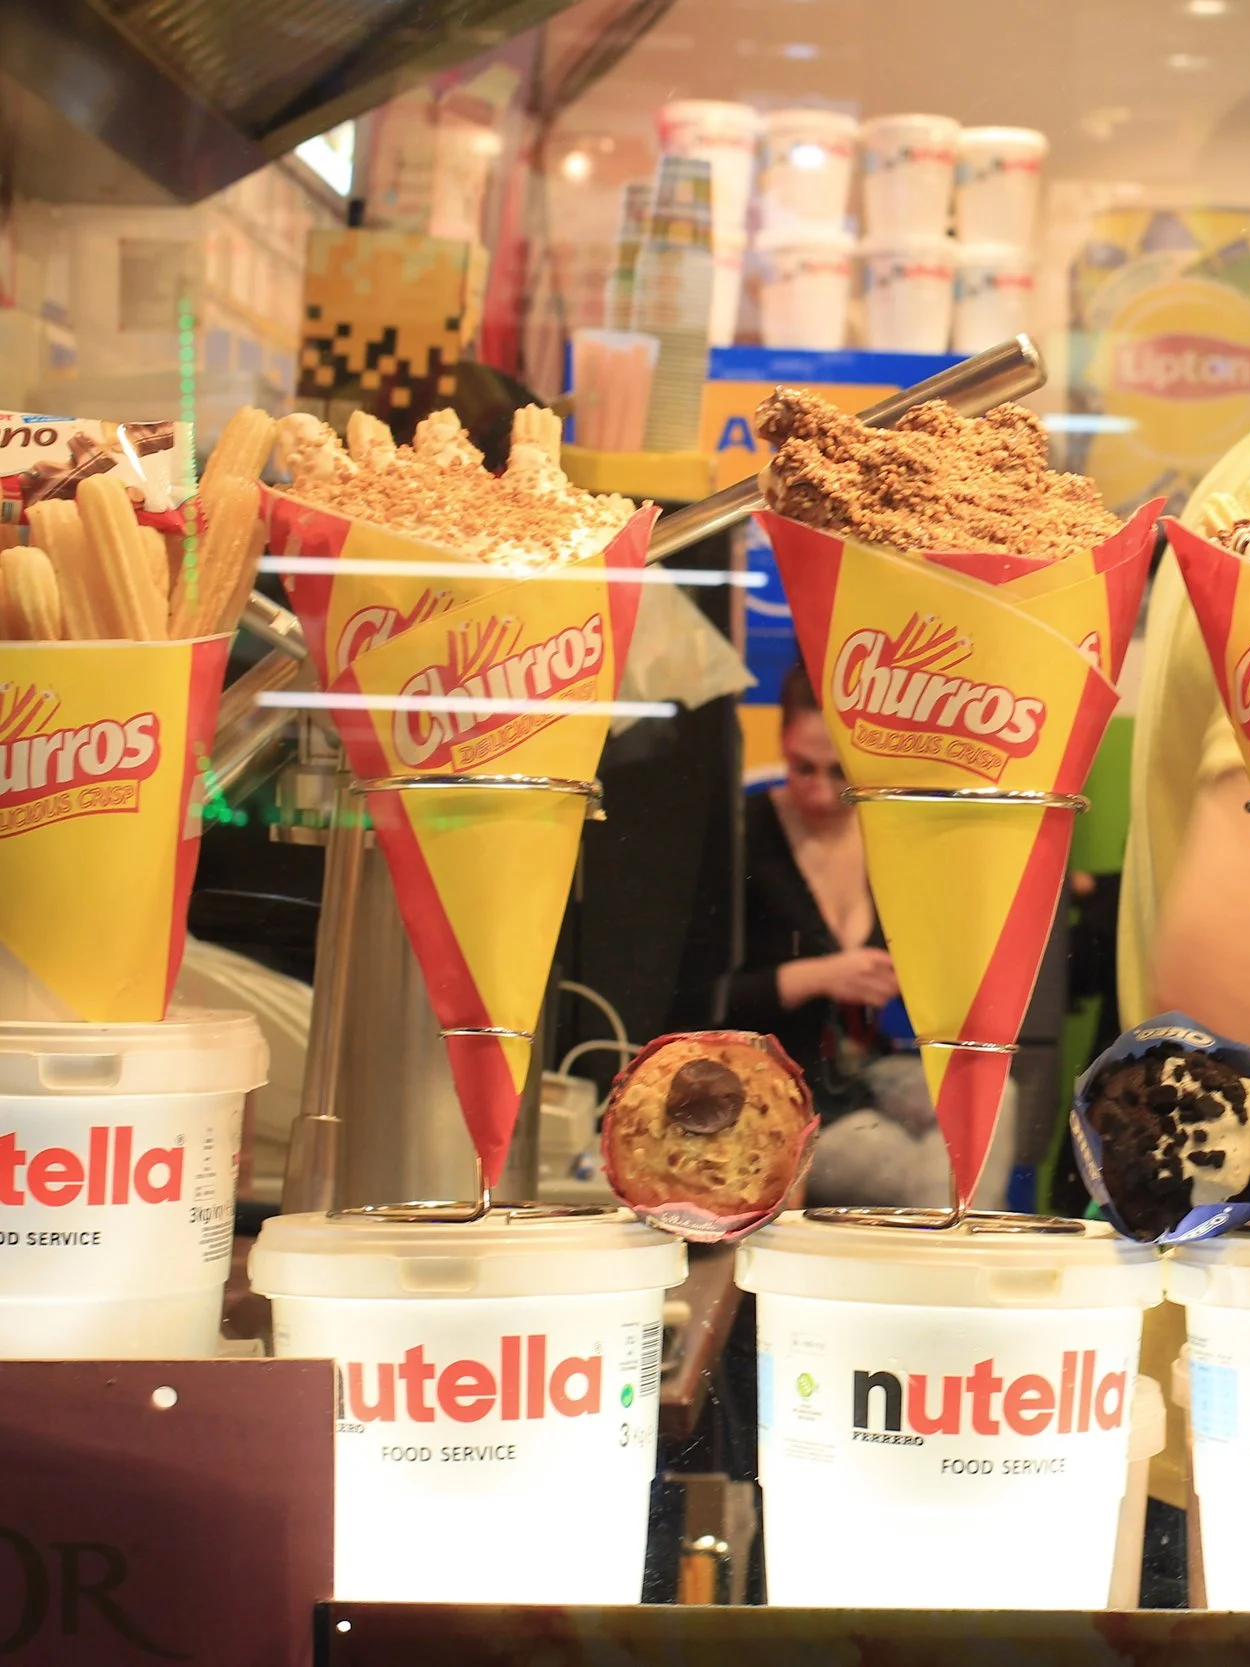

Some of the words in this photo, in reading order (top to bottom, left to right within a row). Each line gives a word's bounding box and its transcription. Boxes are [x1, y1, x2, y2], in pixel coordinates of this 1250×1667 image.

[395, 614, 602, 767] Churros
[833, 630, 1045, 744] Churros
[856, 724, 941, 755] DELICIOUS
[946, 739, 1002, 771] CRISP
[77, 784, 136, 810] CRISP
[26, 1230, 102, 1246] SERVICE
[852, 1350, 1128, 1436] nutella
[851, 1430, 925, 1448] FERRERO
[381, 1446, 432, 1462] FOOD
[440, 1444, 516, 1462] SERVICE
[941, 1458, 994, 1476] FOOD
[1001, 1457, 1066, 1476] SERVICE
